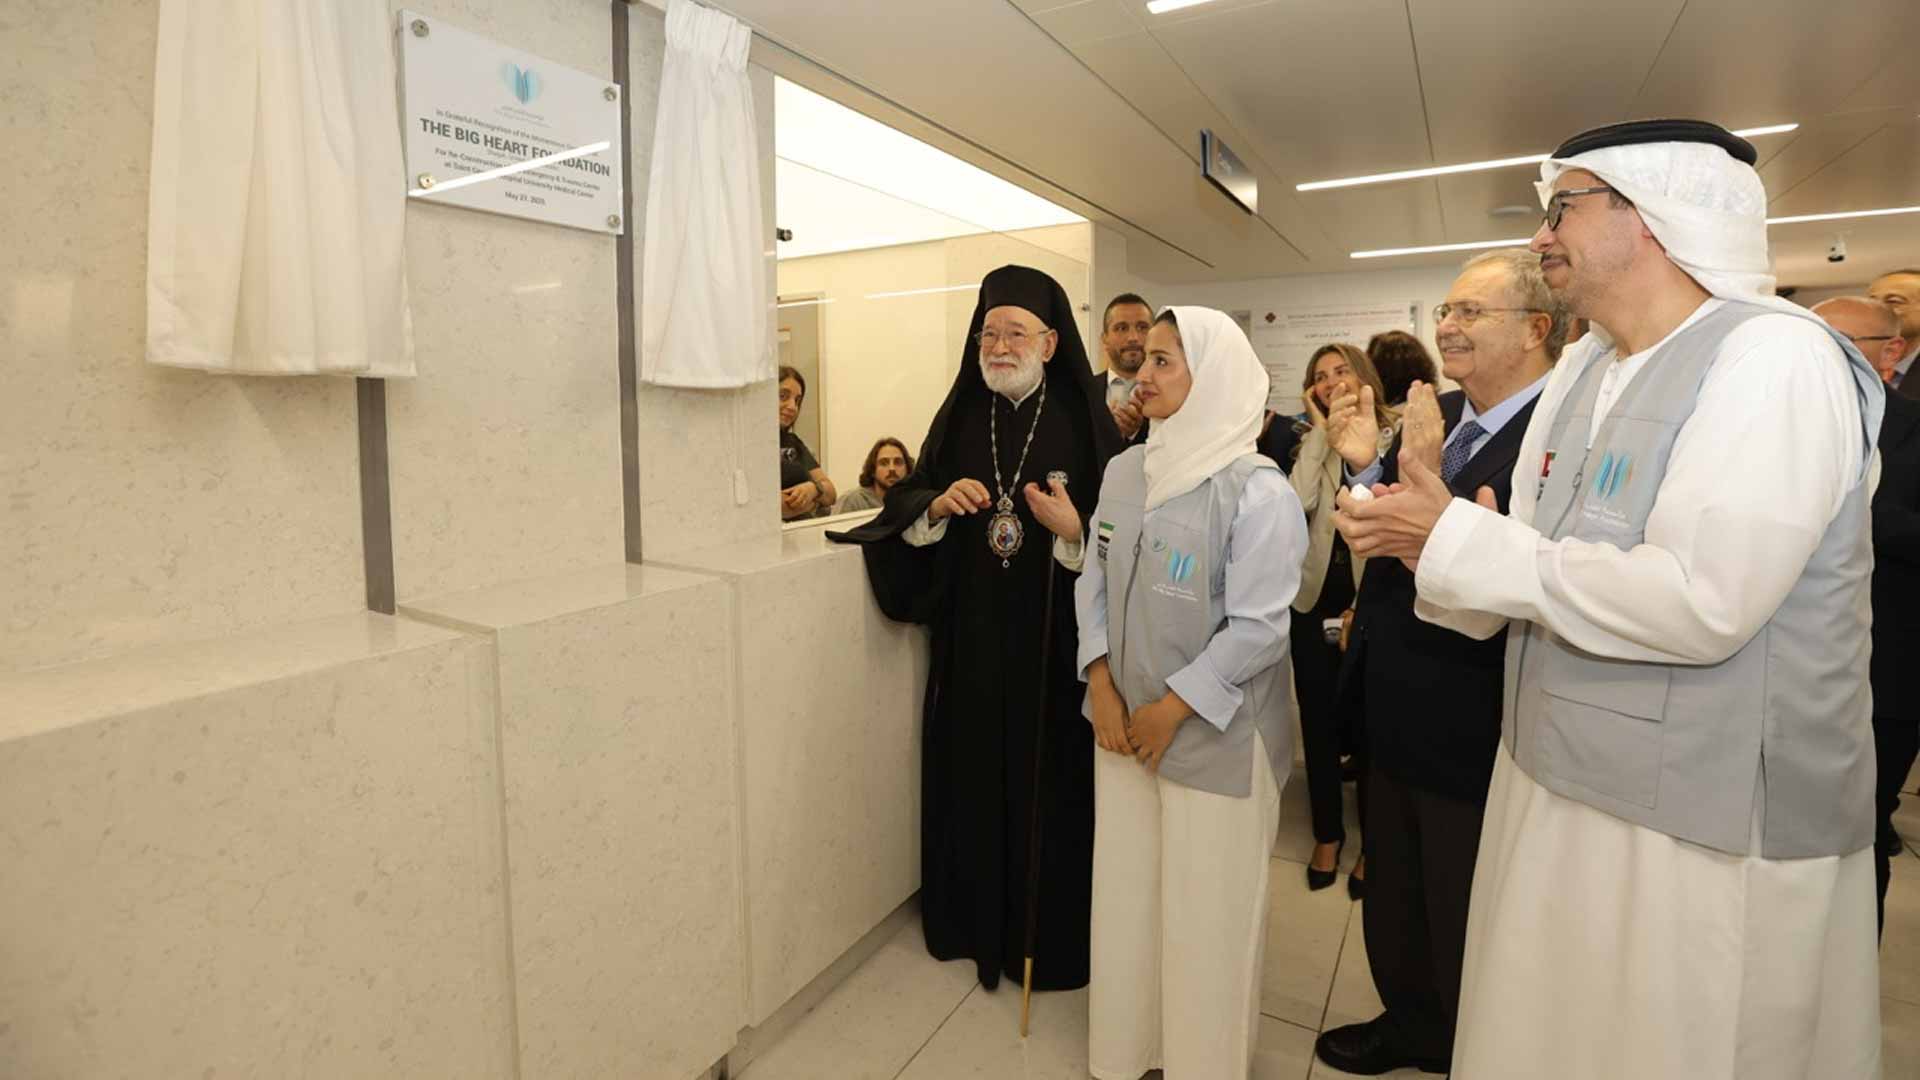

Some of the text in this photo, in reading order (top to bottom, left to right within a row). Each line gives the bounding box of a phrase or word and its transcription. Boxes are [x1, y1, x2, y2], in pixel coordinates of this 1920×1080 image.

[419, 118, 451, 138] THE
[454, 126, 480, 145] BIG
[483, 134, 529, 156] HEART
[532, 146, 610, 177] FONDATION
